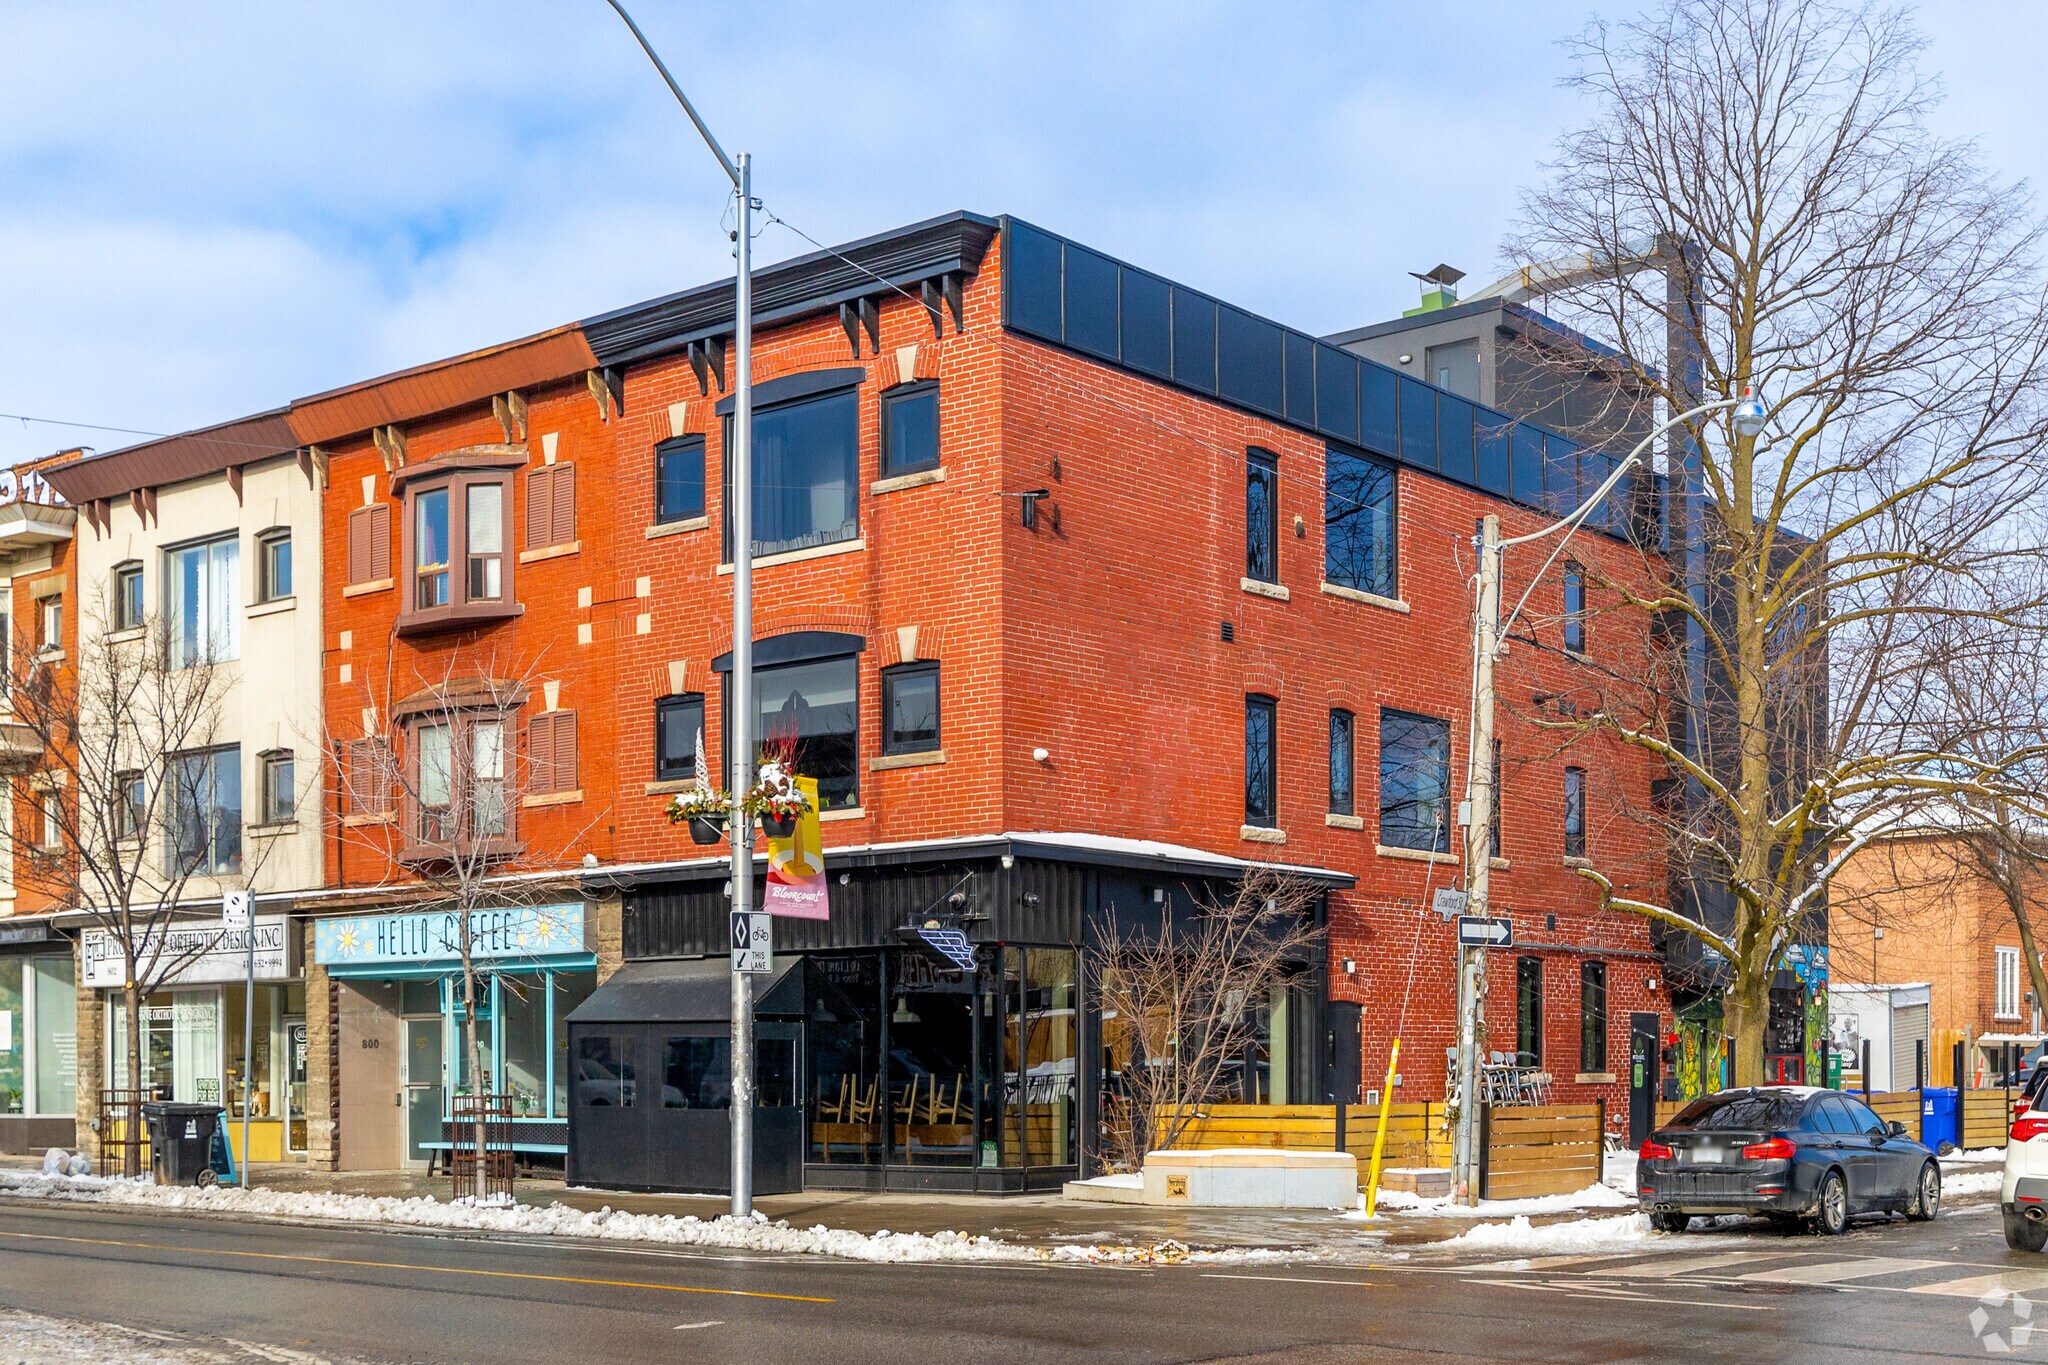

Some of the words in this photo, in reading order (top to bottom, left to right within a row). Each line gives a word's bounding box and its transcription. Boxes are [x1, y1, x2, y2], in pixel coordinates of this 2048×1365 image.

[377, 917, 428, 955] HELLO
[106, 933, 169, 956] PRORESSIVE
[170, 931, 220, 952] ORTHOTIC
[260, 927, 282, 948] INC.
[752, 951, 765, 960] THIS
[750, 961, 767, 970] LANE
[361, 1039, 379, 1049] 800
